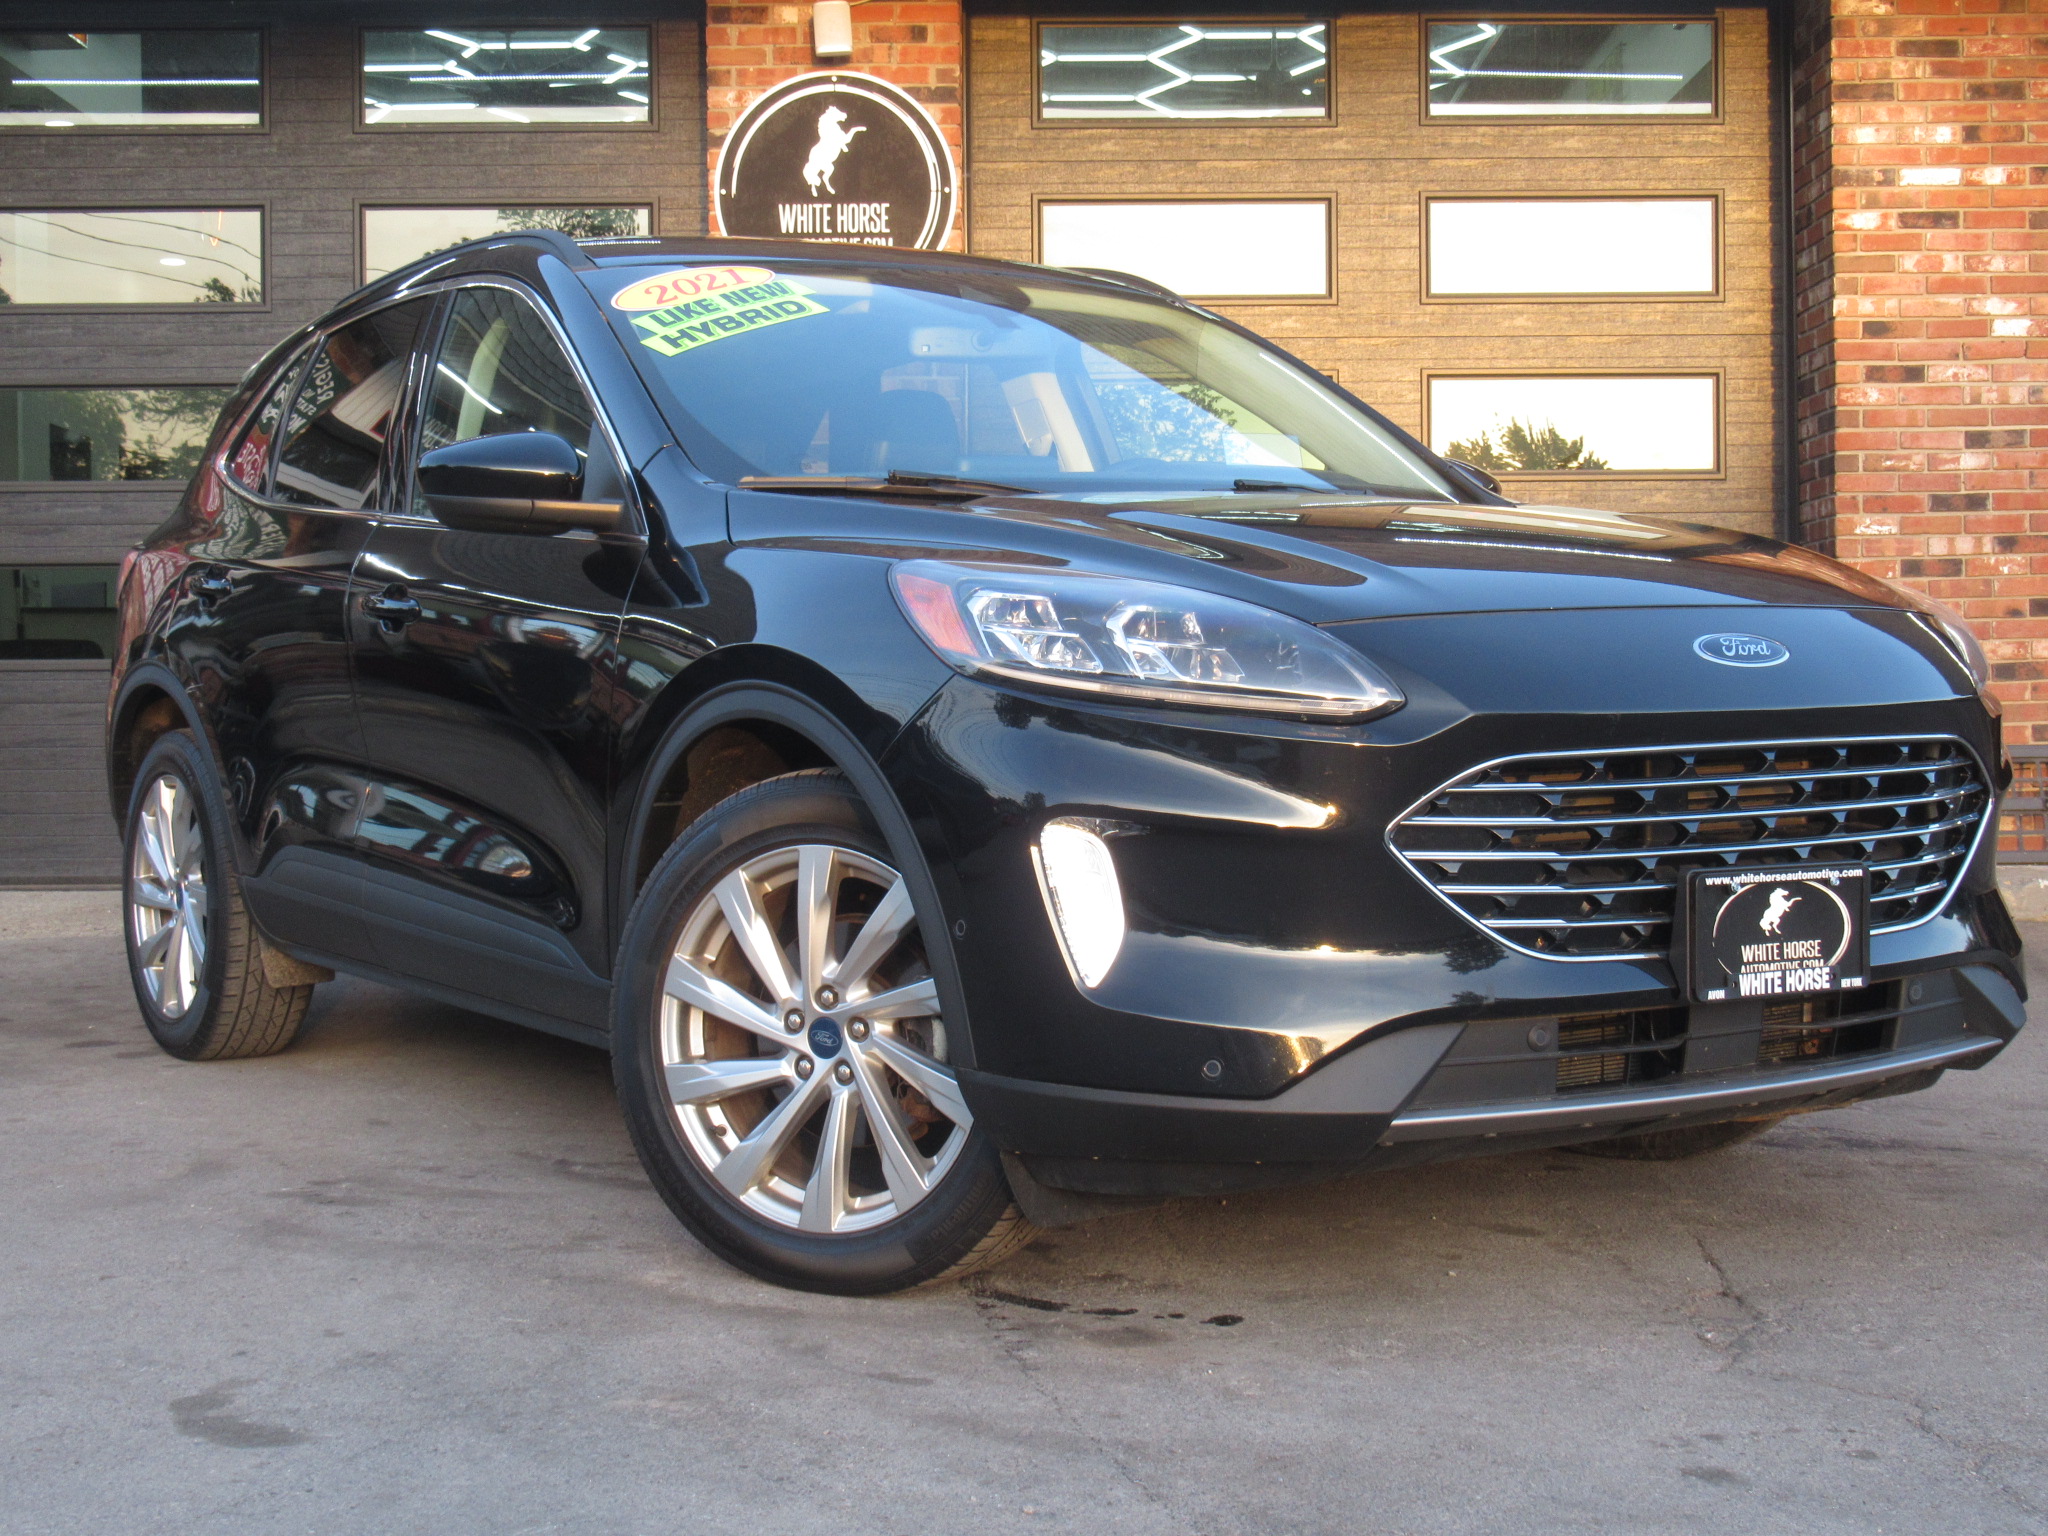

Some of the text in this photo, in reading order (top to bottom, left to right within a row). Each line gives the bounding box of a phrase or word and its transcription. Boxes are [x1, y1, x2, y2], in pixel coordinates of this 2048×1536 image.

[778, 202, 891, 234] WHITE HORSE
[644, 268, 751, 305] 2021
[648, 281, 793, 328] LIKE NEW
[659, 300, 809, 350] HYBRID
[1719, 637, 1771, 657] Ford
[1705, 868, 1863, 886] www.whitehorseautomotive.com
[1741, 940, 1822, 963] WHITE HORSE
[1707, 988, 1725, 1000] AVON
[1738, 966, 1831, 997] WHITE HORSE
[814, 1031, 834, 1045] Ford
